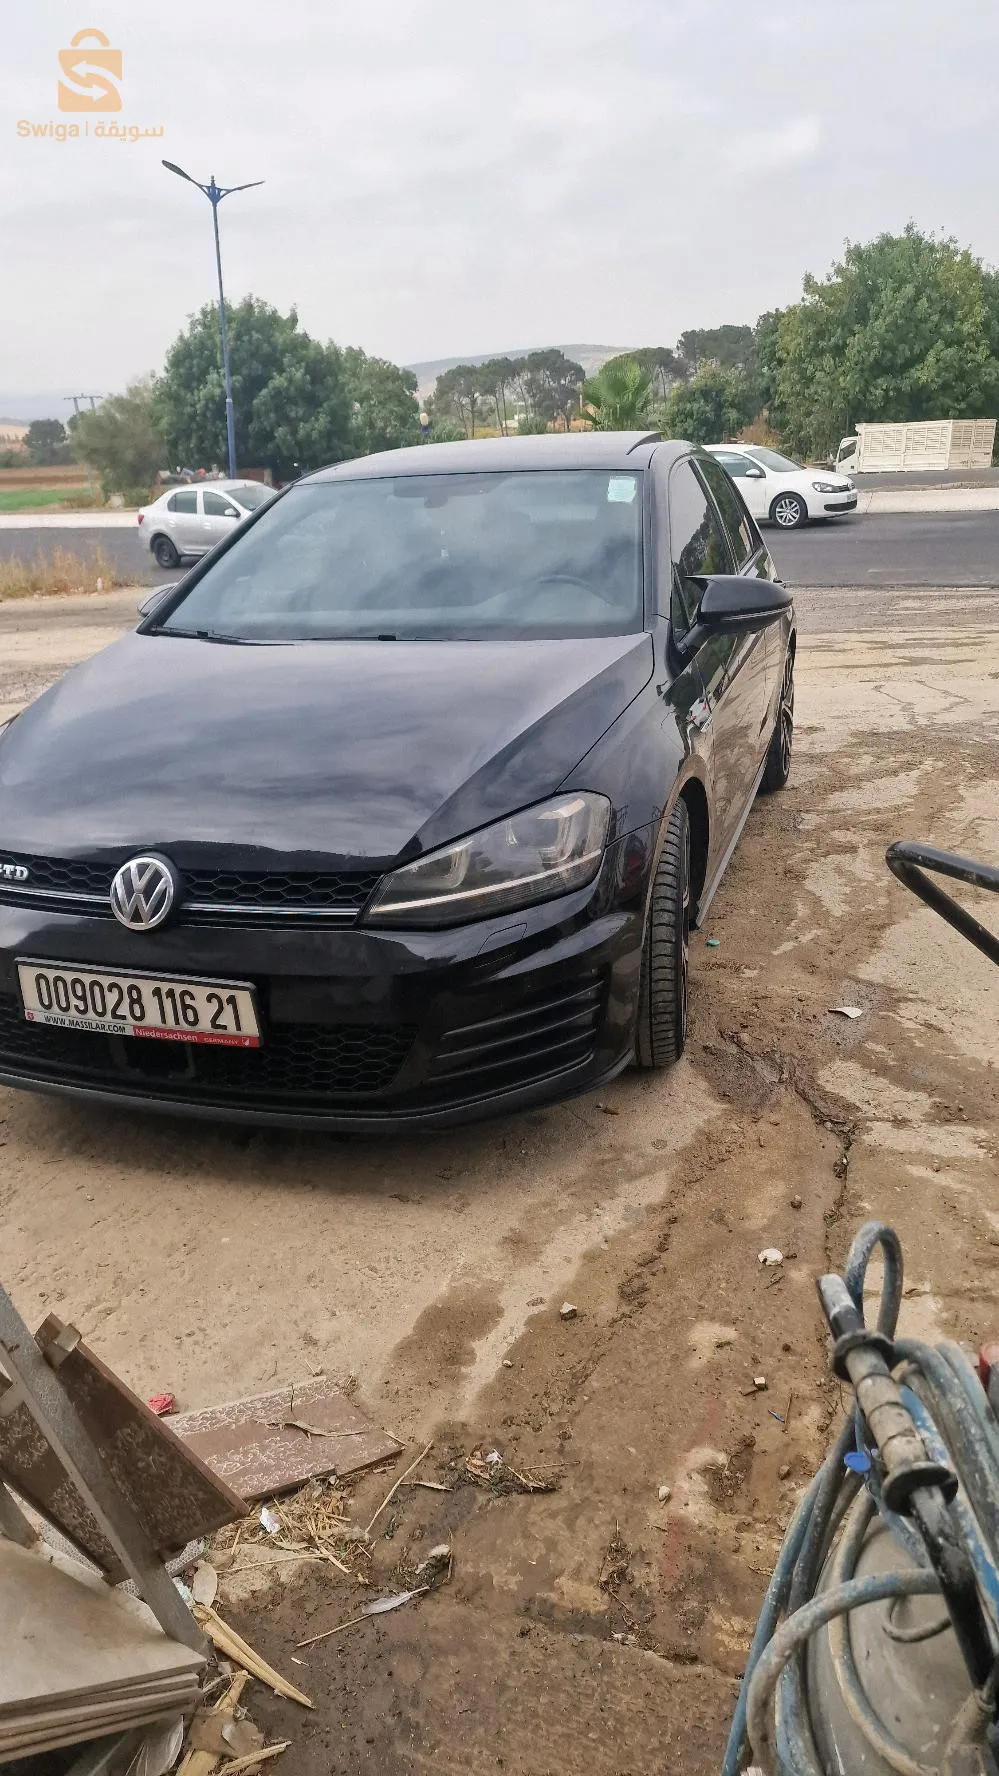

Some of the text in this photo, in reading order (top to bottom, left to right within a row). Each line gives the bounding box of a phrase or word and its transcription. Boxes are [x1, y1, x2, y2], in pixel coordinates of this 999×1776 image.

[0, 863, 28, 881] TD
[34, 972, 242, 1032] 009028 116 21
[135, 1028, 198, 1042] Niedersachsen
